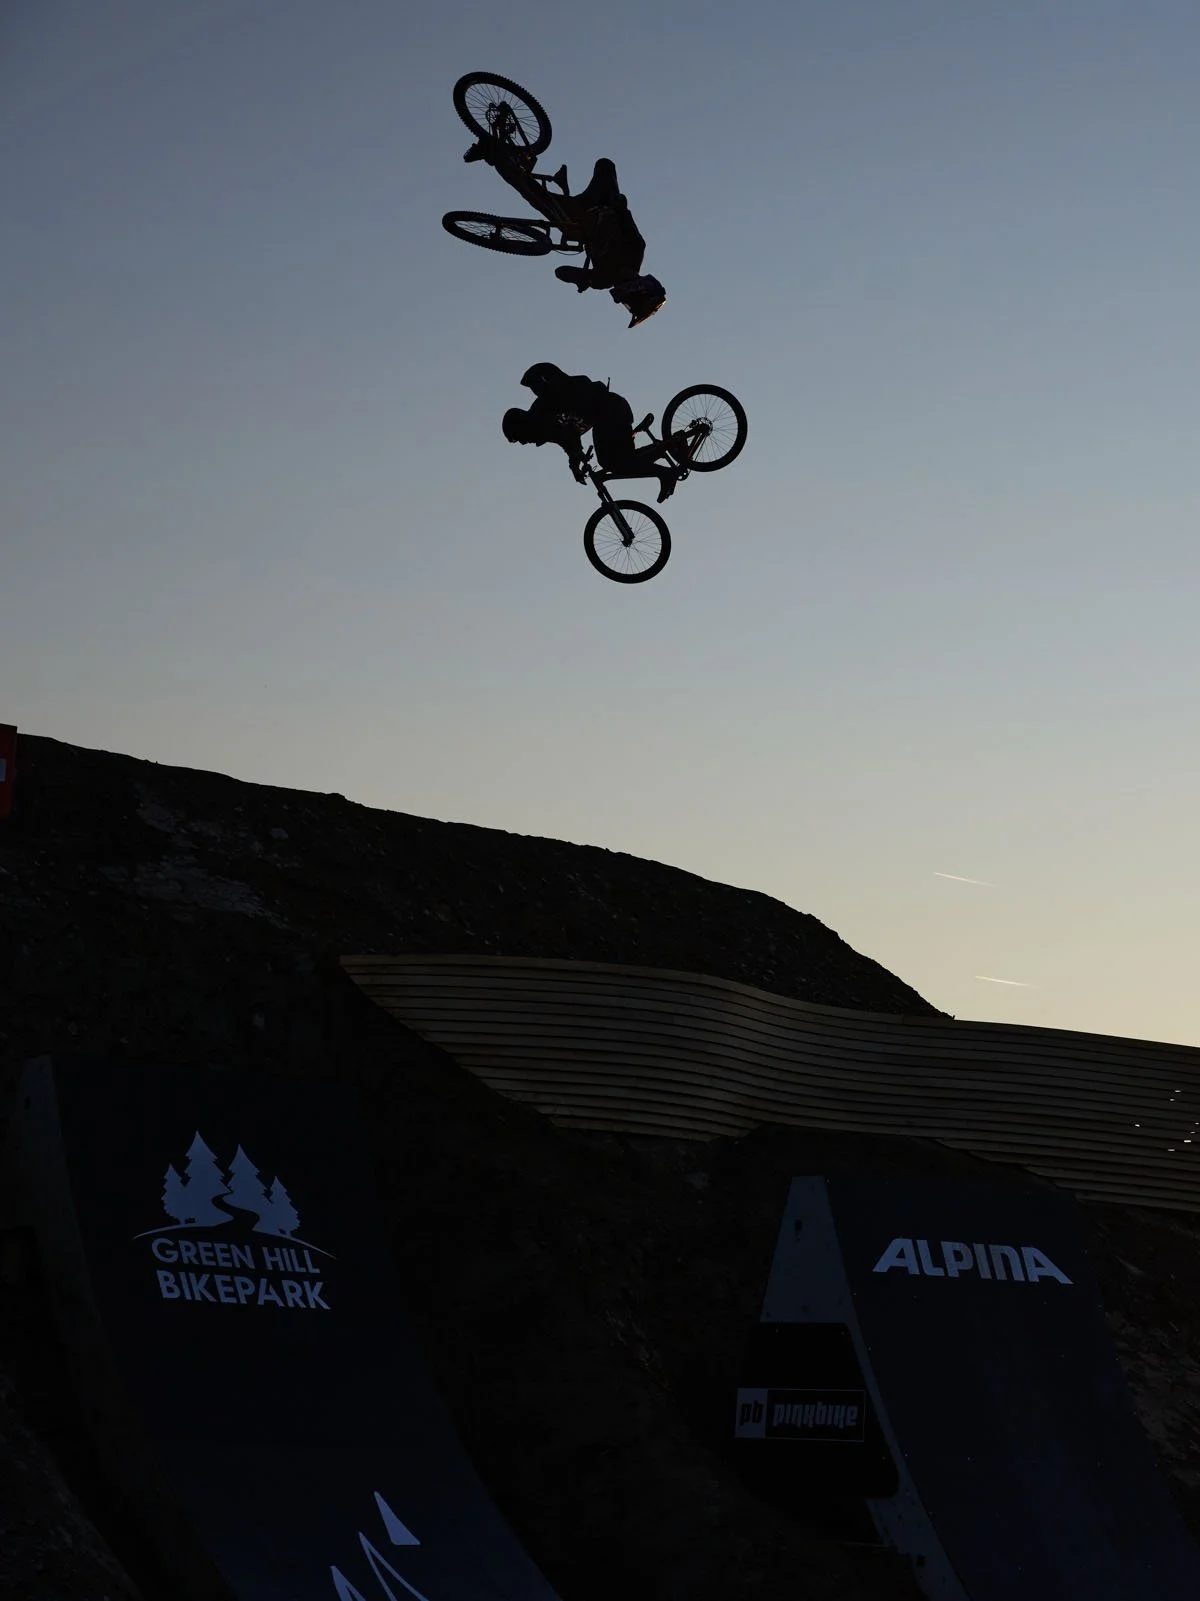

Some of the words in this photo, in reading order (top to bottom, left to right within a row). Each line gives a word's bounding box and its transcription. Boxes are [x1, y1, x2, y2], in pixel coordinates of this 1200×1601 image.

[151, 1237, 256, 1269] GREEN
[261, 1246, 321, 1274] HILL
[872, 1237, 1075, 1285] ALPINA
[156, 1269, 332, 1310] BIKEPARK
[772, 1401, 858, 1428] pinkbike
